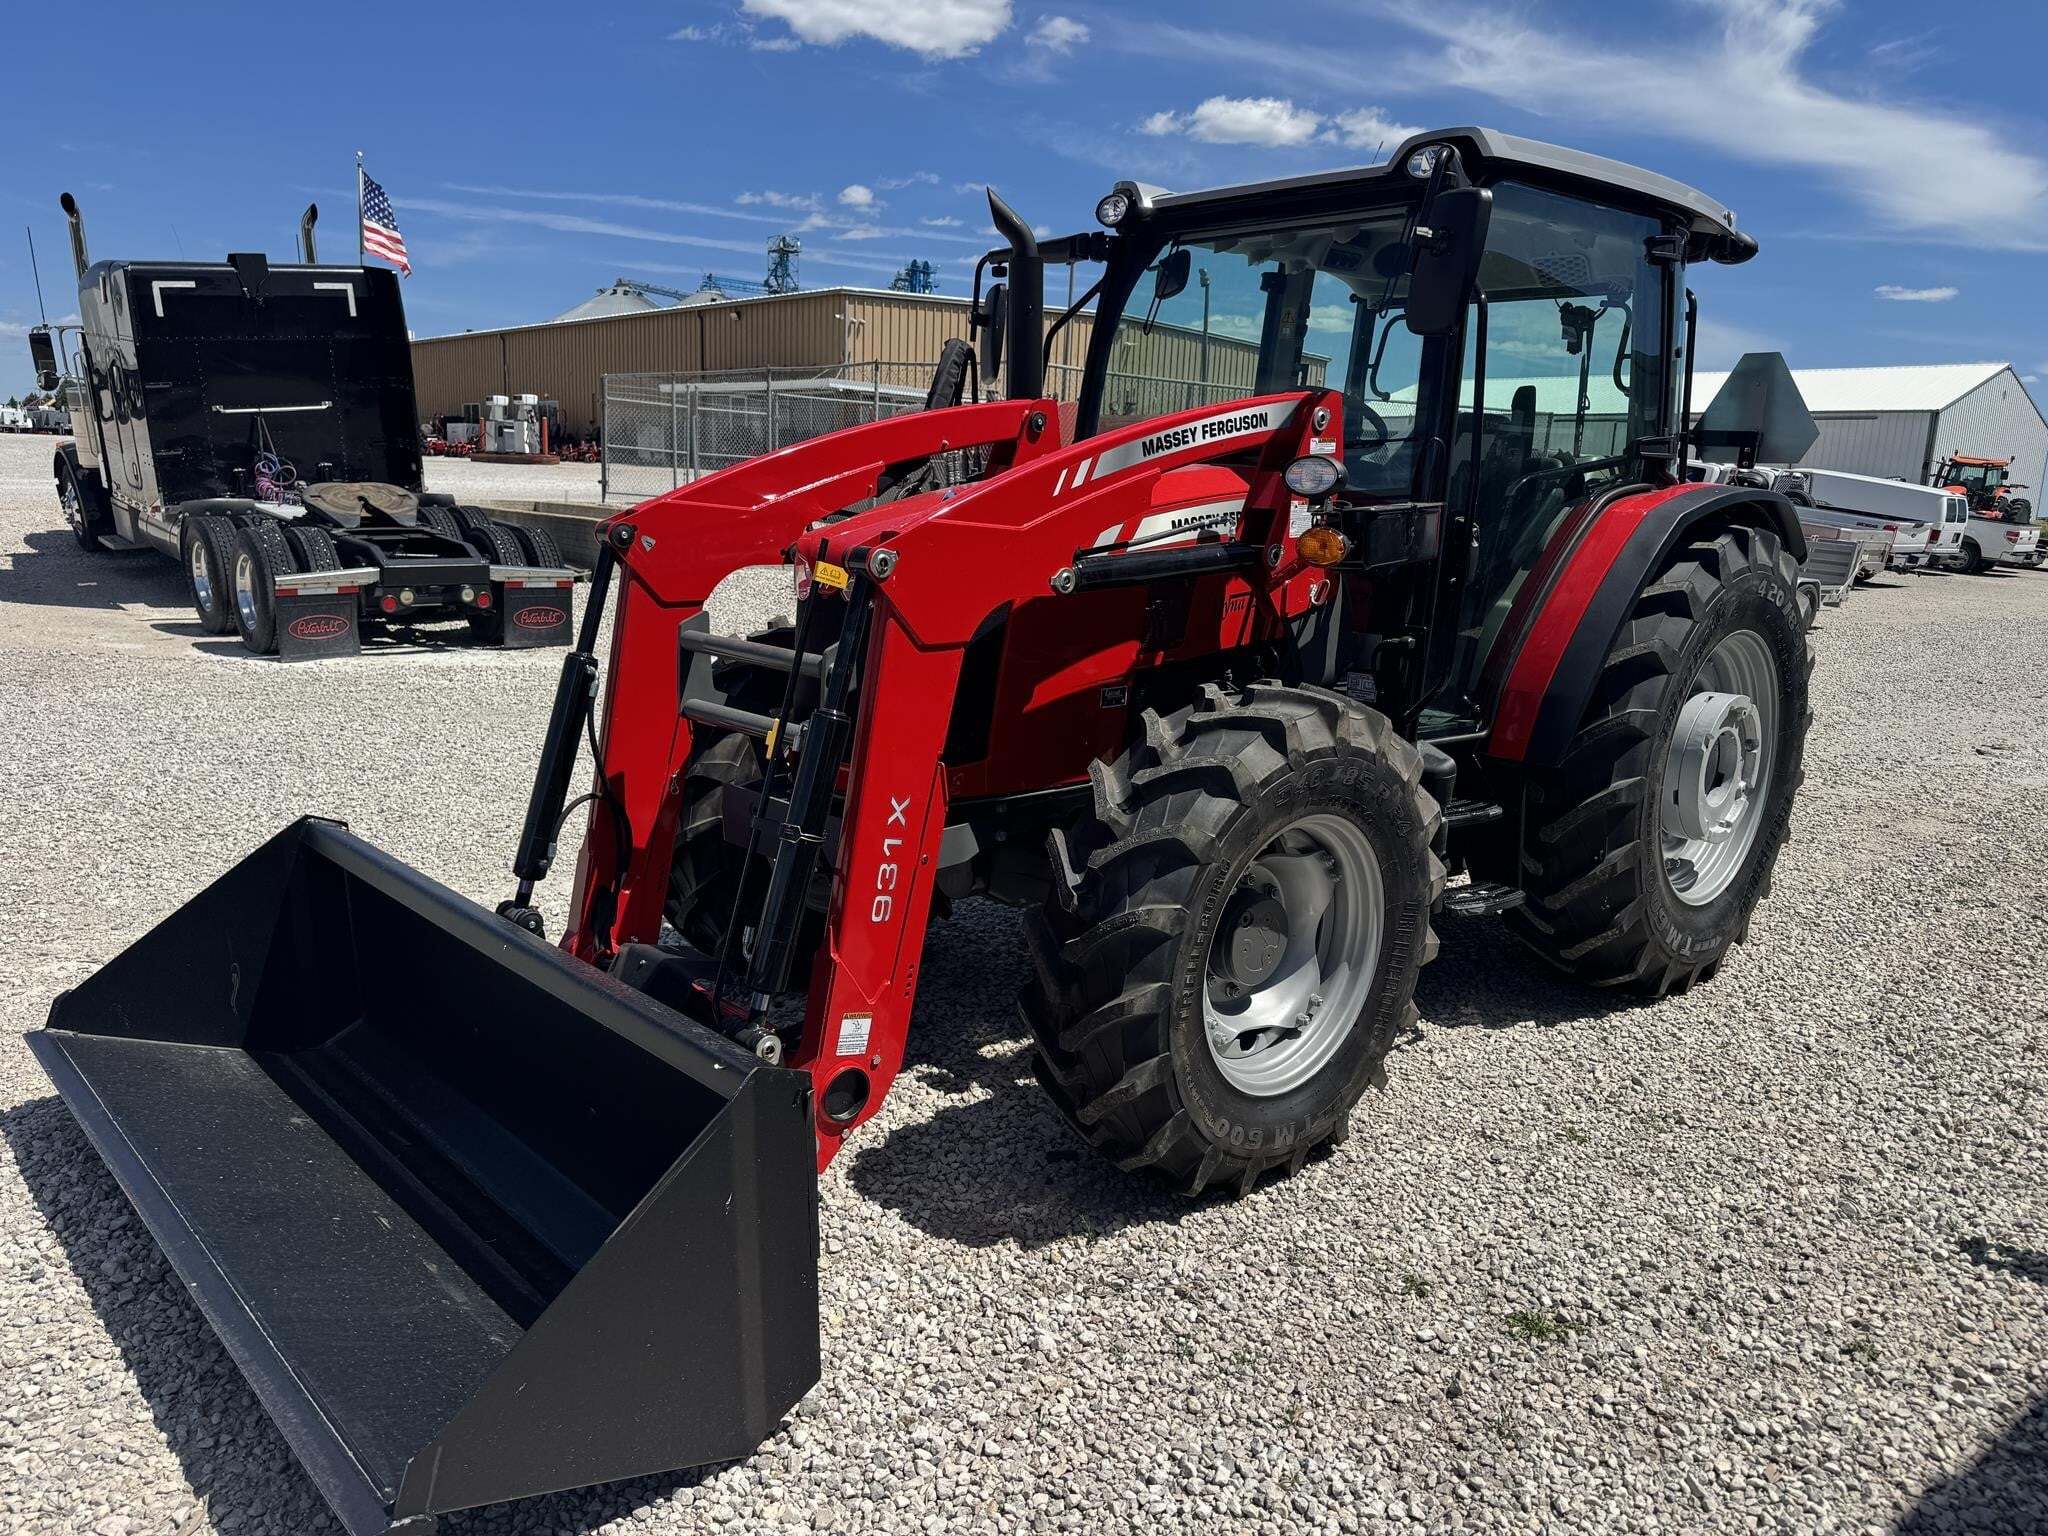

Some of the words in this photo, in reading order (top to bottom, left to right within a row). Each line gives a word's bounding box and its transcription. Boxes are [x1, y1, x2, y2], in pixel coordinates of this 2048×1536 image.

[1141, 426, 1198, 457] MASSEY
[1201, 411, 1269, 440] FERGUSON
[520, 610, 560, 624] Peterbilt
[297, 620, 341, 635] Peterbilt
